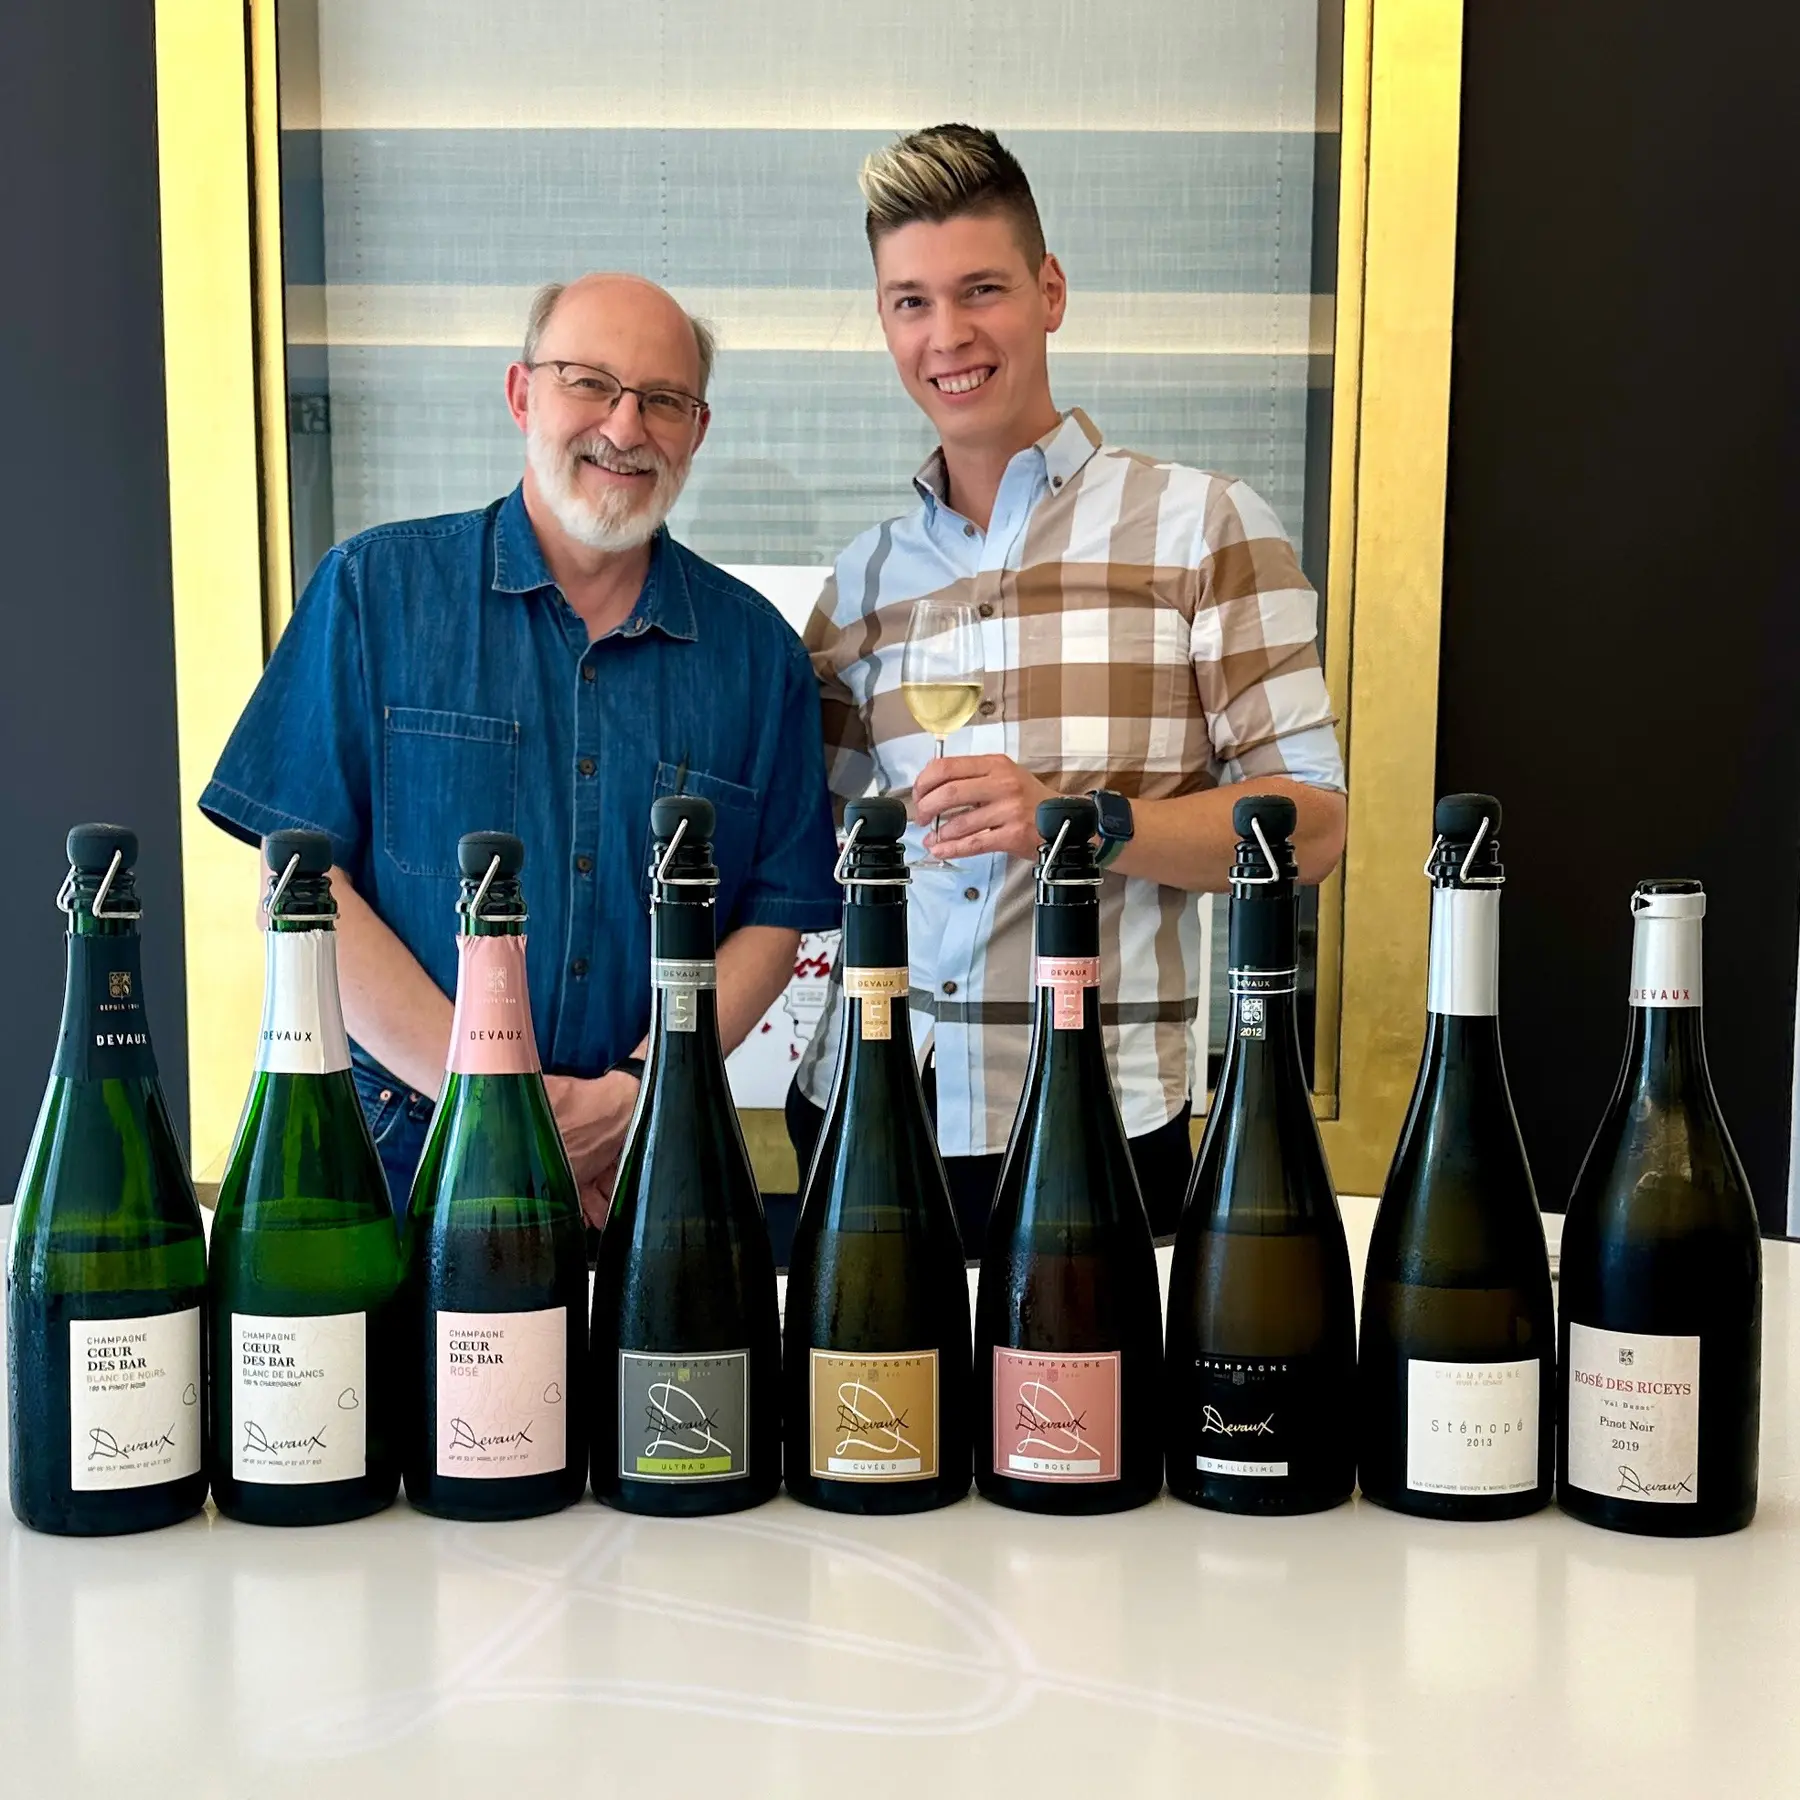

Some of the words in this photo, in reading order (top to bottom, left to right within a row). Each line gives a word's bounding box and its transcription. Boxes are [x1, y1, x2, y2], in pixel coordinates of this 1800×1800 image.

[1633, 989, 1690, 1000] DEVAUX
[263, 1030, 312, 1042] DEVAUX
[470, 1030, 522, 1040] DEVAUX
[1240, 1027, 1262, 1037] 2012
[96, 1033, 147, 1046] DEVAUX
[86, 1333, 148, 1345] CHAMPAGNE
[242, 1330, 297, 1341] CHAMPAGNE
[449, 1329, 505, 1338] CHAMPAGNE
[242, 1342, 281, 1354] CŒUR
[449, 1340, 490, 1351] CŒUR
[87, 1346, 132, 1358] CŒUR
[87, 1360, 115, 1371] DES
[119, 1358, 147, 1370] BAR
[242, 1354, 265, 1367] DES
[269, 1356, 295, 1367] BAR
[449, 1353, 474, 1364] DES
[477, 1354, 504, 1364] BAR
[636, 1360, 731, 1368] CHAMPAGNE
[828, 1360, 921, 1368] CHAMPAGNE
[1007, 1358, 1101, 1368] CHAMPAGNE
[450, 1365, 479, 1377] ROSÉ
[1195, 1359, 1287, 1372] CHAMPAGNE
[86, 1373, 120, 1383] BLANC
[122, 1371, 136, 1381] DE
[137, 1368, 166, 1379] NOIRS
[242, 1368, 270, 1378] BLANC
[272, 1370, 284, 1379] DE
[287, 1369, 325, 1379] BLANCS
[1435, 1370, 1521, 1380] CHAMPAGNE
[1575, 1370, 1603, 1388] ROSÉ
[1606, 1377, 1633, 1392] DES
[1636, 1381, 1692, 1395] RICEYS
[645, 1405, 719, 1435] Devaux
[836, 1404, 909, 1435] Devaux
[1015, 1403, 1088, 1434] Devaux
[1201, 1404, 1275, 1437] Devaux
[1599, 1416, 1627, 1430] Pinot
[1629, 1420, 1655, 1433] Noir
[1431, 1418, 1523, 1435] Sténopé
[242, 1420, 327, 1456] Devaux
[449, 1417, 533, 1452] Devaux
[88, 1422, 175, 1460] Devaux
[1466, 1438, 1492, 1447] 2013
[1612, 1439, 1639, 1452] 2019
[661, 1463, 694, 1471] ULTRA
[853, 1462, 885, 1471] CUVÉE
[1617, 1465, 1692, 1496] Devaux
